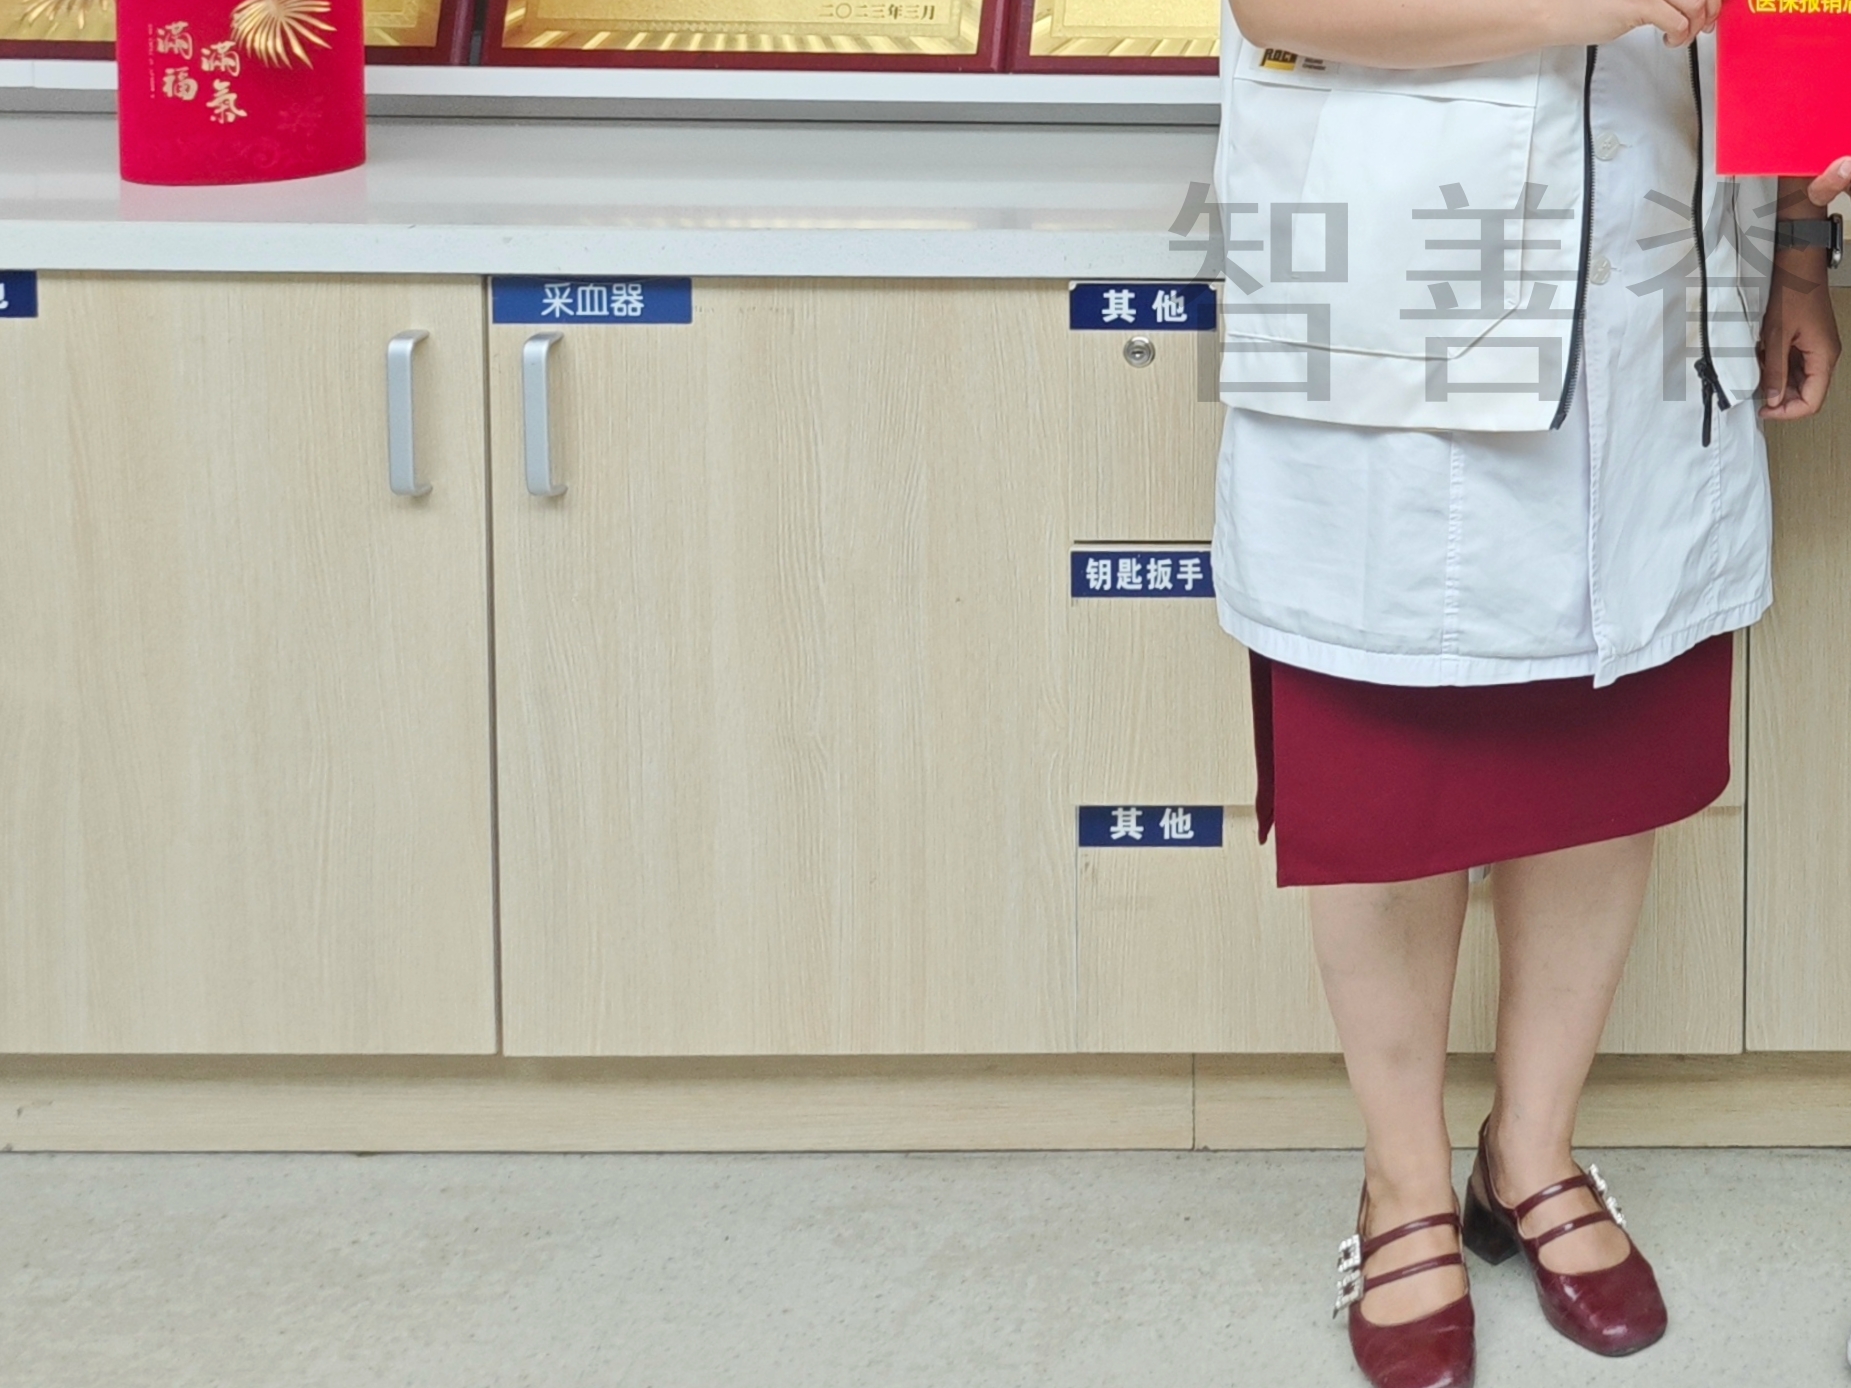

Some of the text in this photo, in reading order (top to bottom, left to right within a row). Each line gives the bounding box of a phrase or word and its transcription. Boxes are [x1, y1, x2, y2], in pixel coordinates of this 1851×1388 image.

[541, 283, 644, 317] 采血器
[1102, 289, 1188, 323] 其他
[1086, 558, 1203, 591] 钥匙扳手
[1109, 808, 1194, 840] 其他
